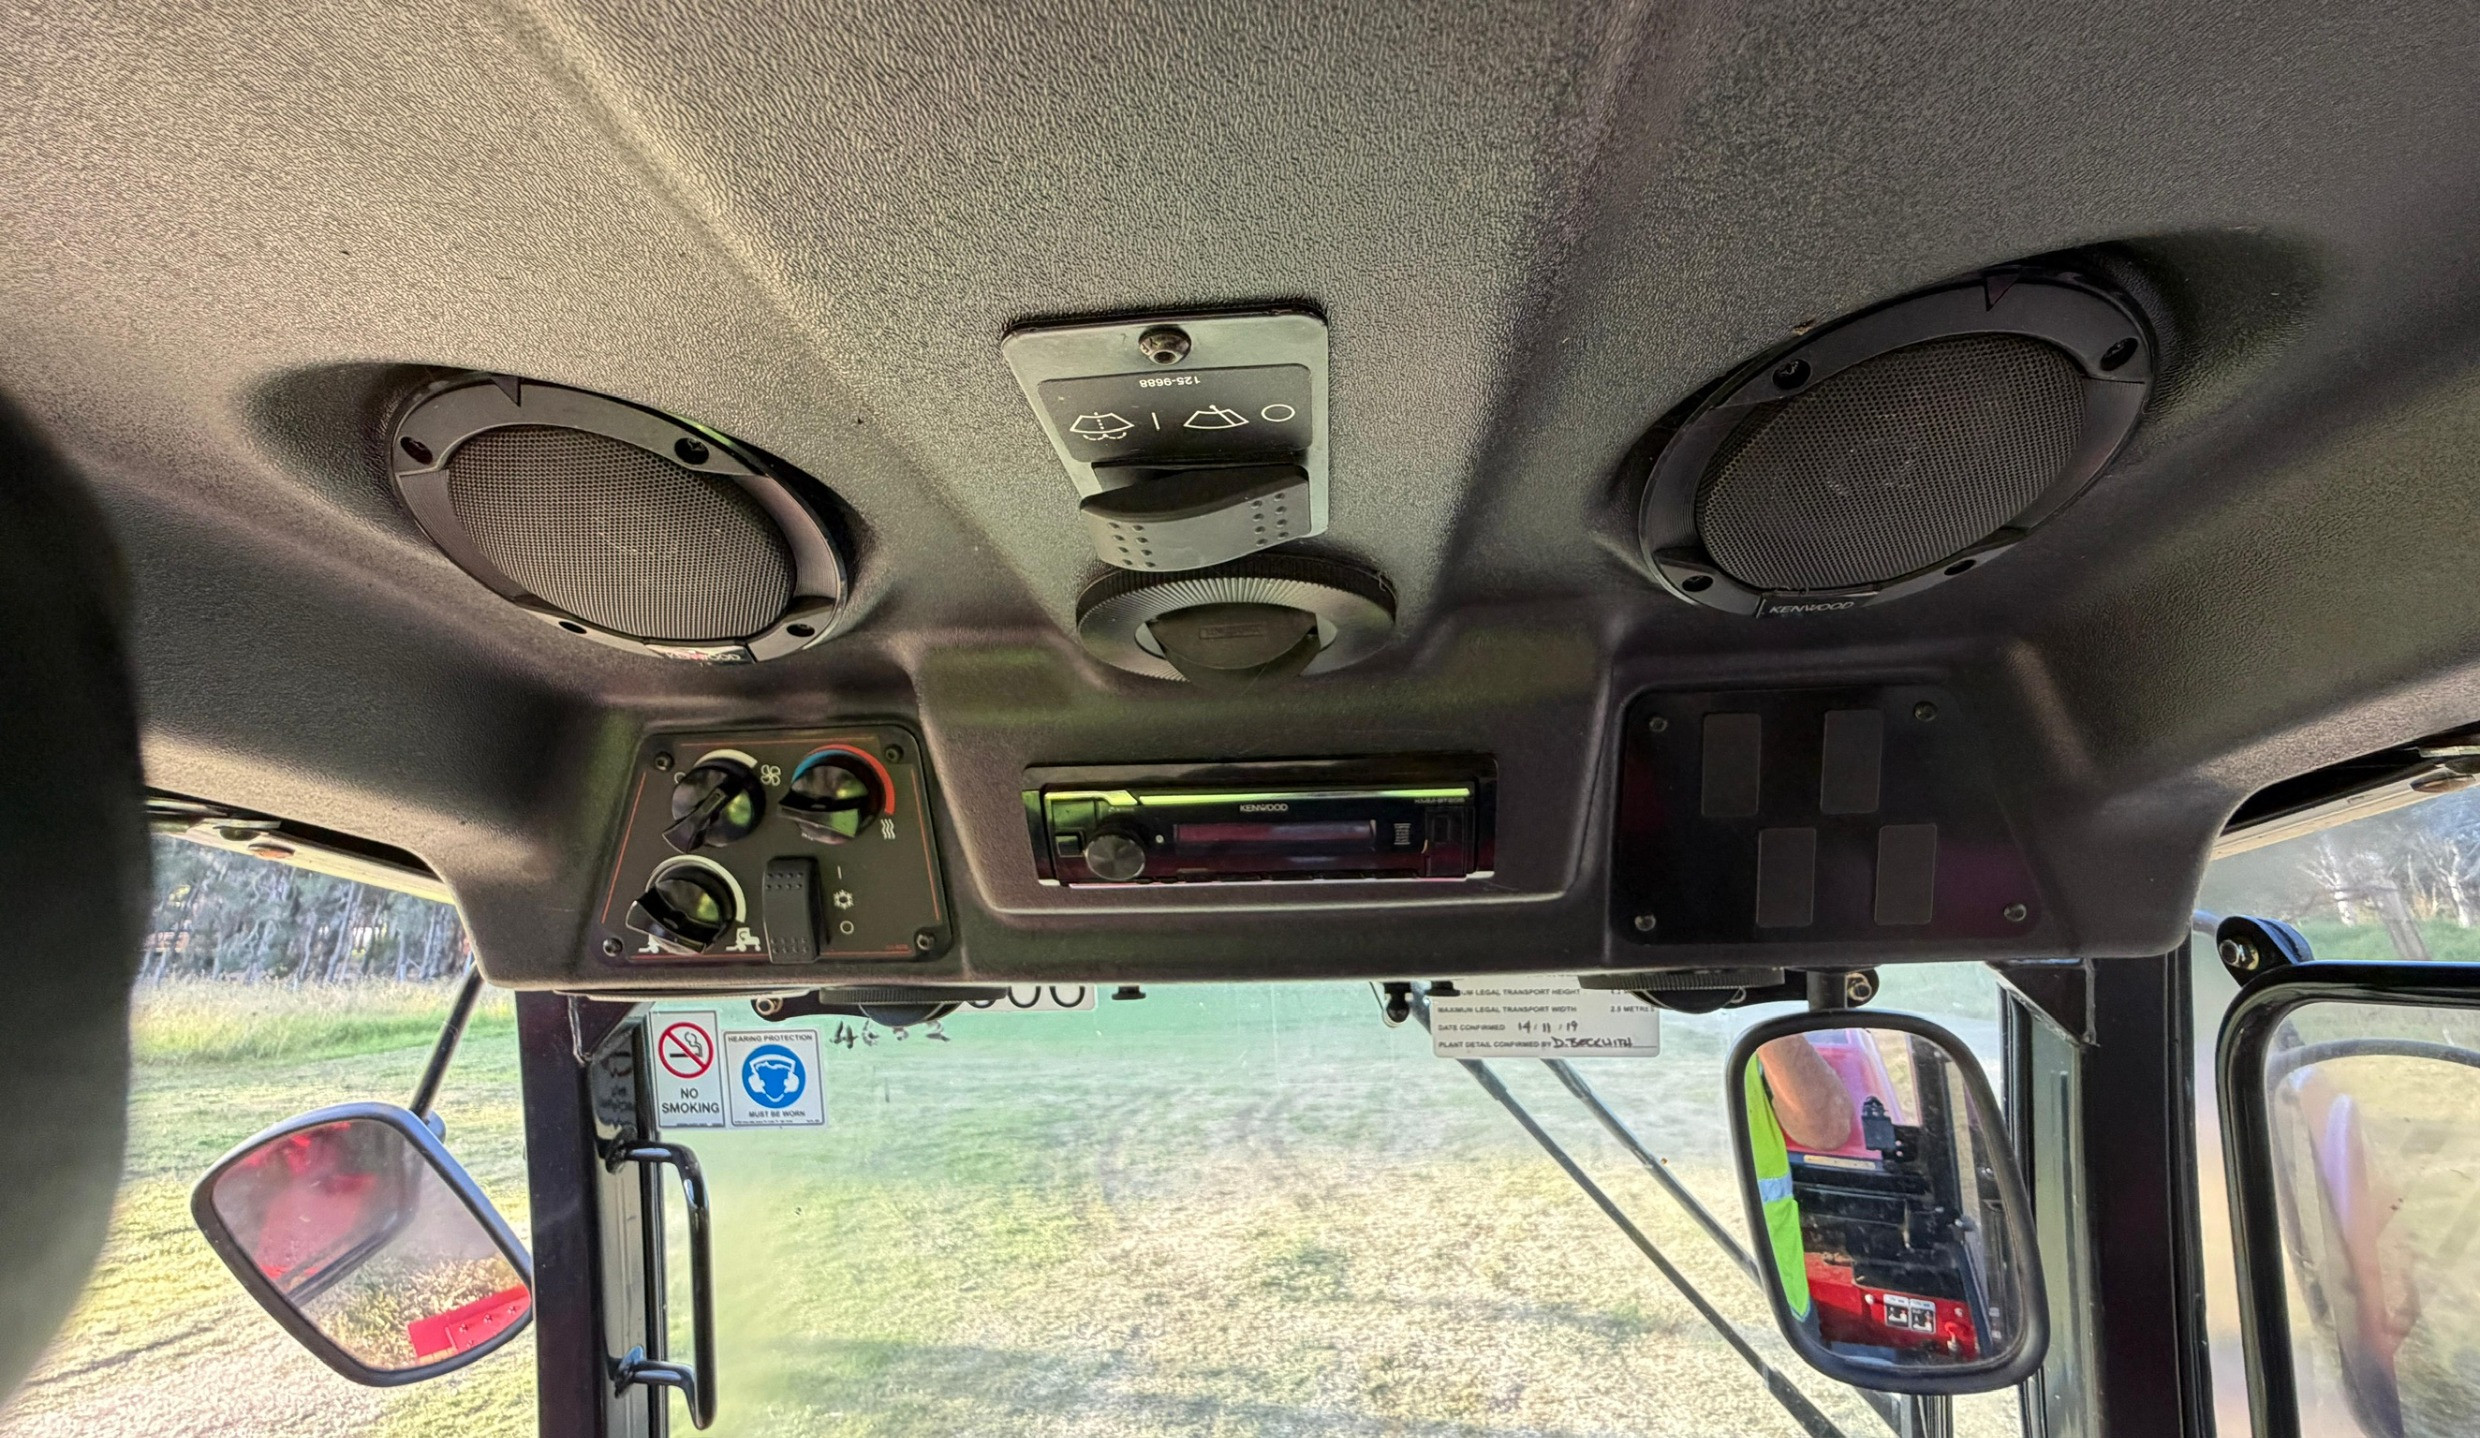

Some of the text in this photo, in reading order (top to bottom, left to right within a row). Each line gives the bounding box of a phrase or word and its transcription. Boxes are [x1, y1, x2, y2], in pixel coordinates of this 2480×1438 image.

[1139, 376, 1201, 388] 125-9688
[1769, 601, 1855, 614] KENWOOD
[1239, 803, 1289, 812] KENWOOD
[680, 1087, 699, 1099] NO
[661, 1102, 720, 1114] SMOKING
[749, 1110, 768, 1118] MUST
